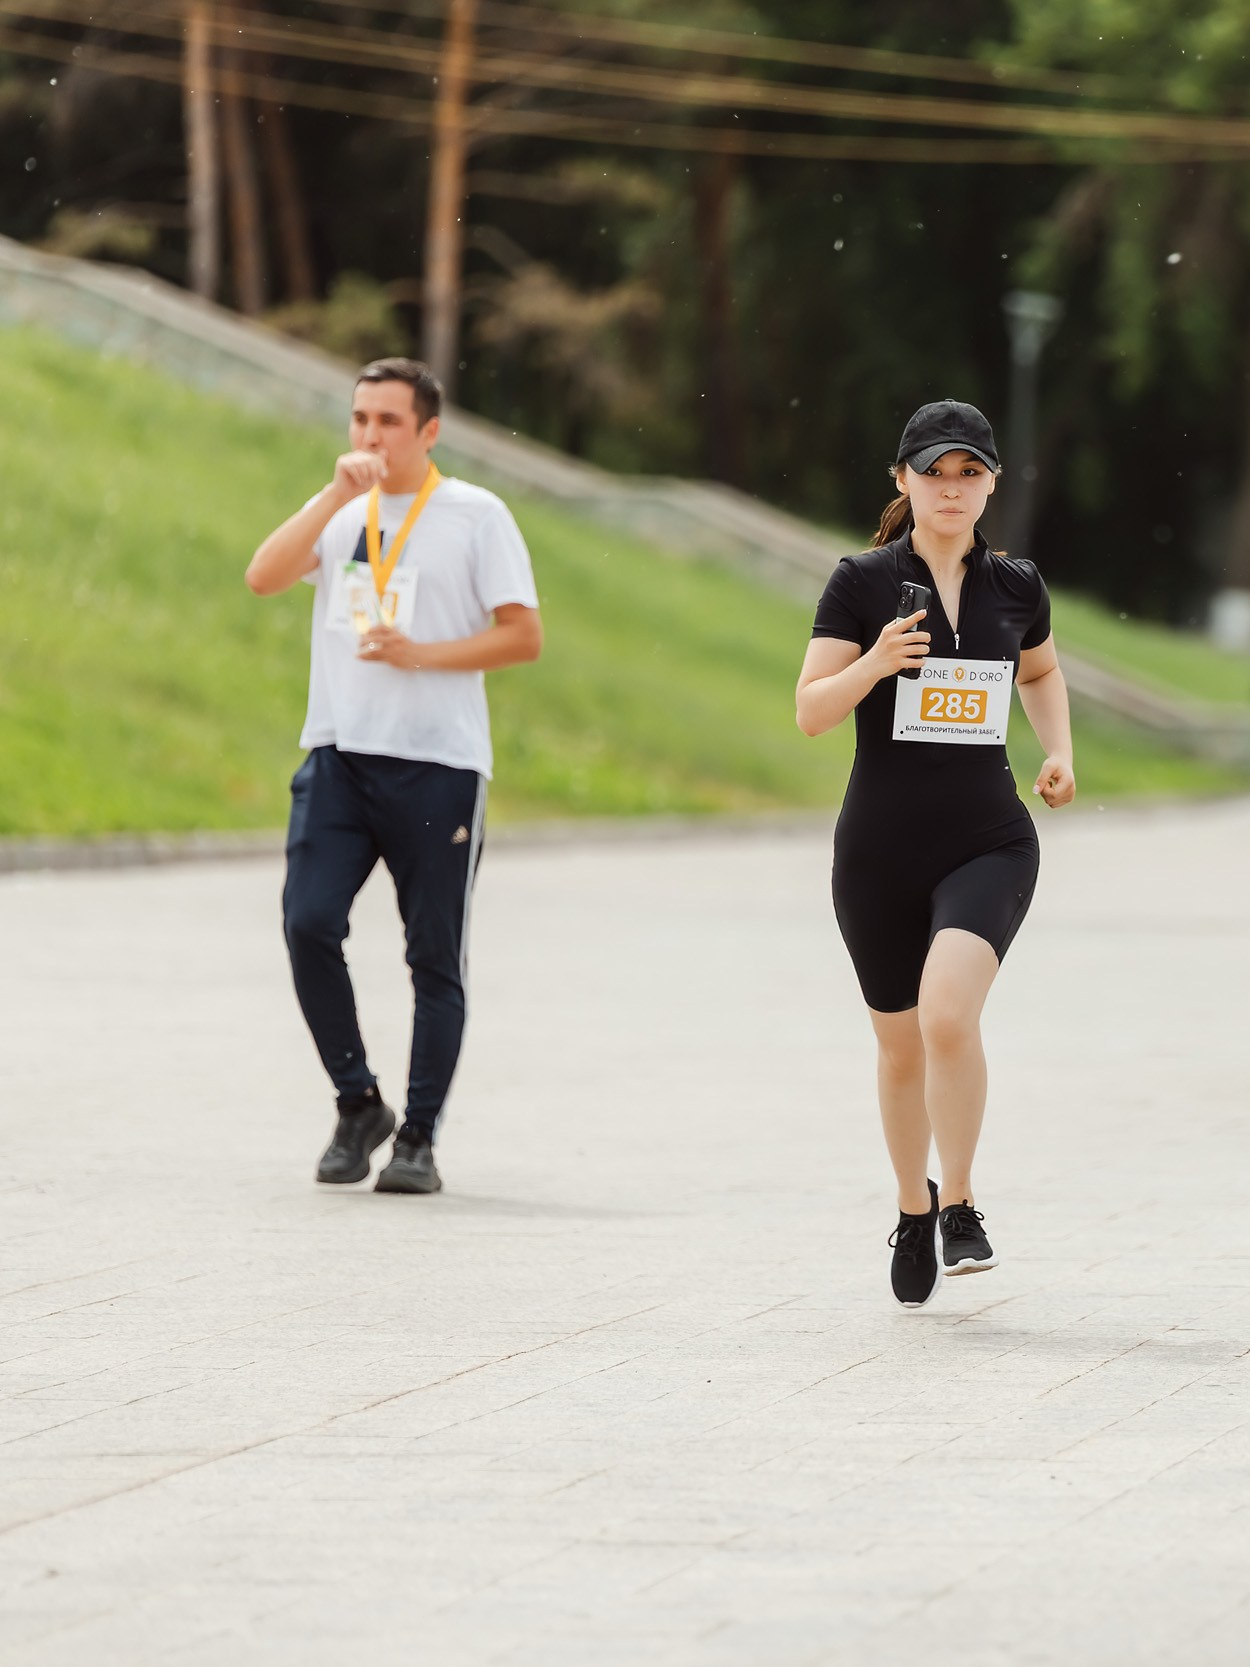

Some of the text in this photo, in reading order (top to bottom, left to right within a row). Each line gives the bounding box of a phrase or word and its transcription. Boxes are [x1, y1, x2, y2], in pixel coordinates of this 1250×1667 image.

[919, 669, 949, 680] ONE
[926, 691, 981, 720] 285
[905, 725, 977, 735] БЛАГОТВОРИТЕЛЬНЫЙ
